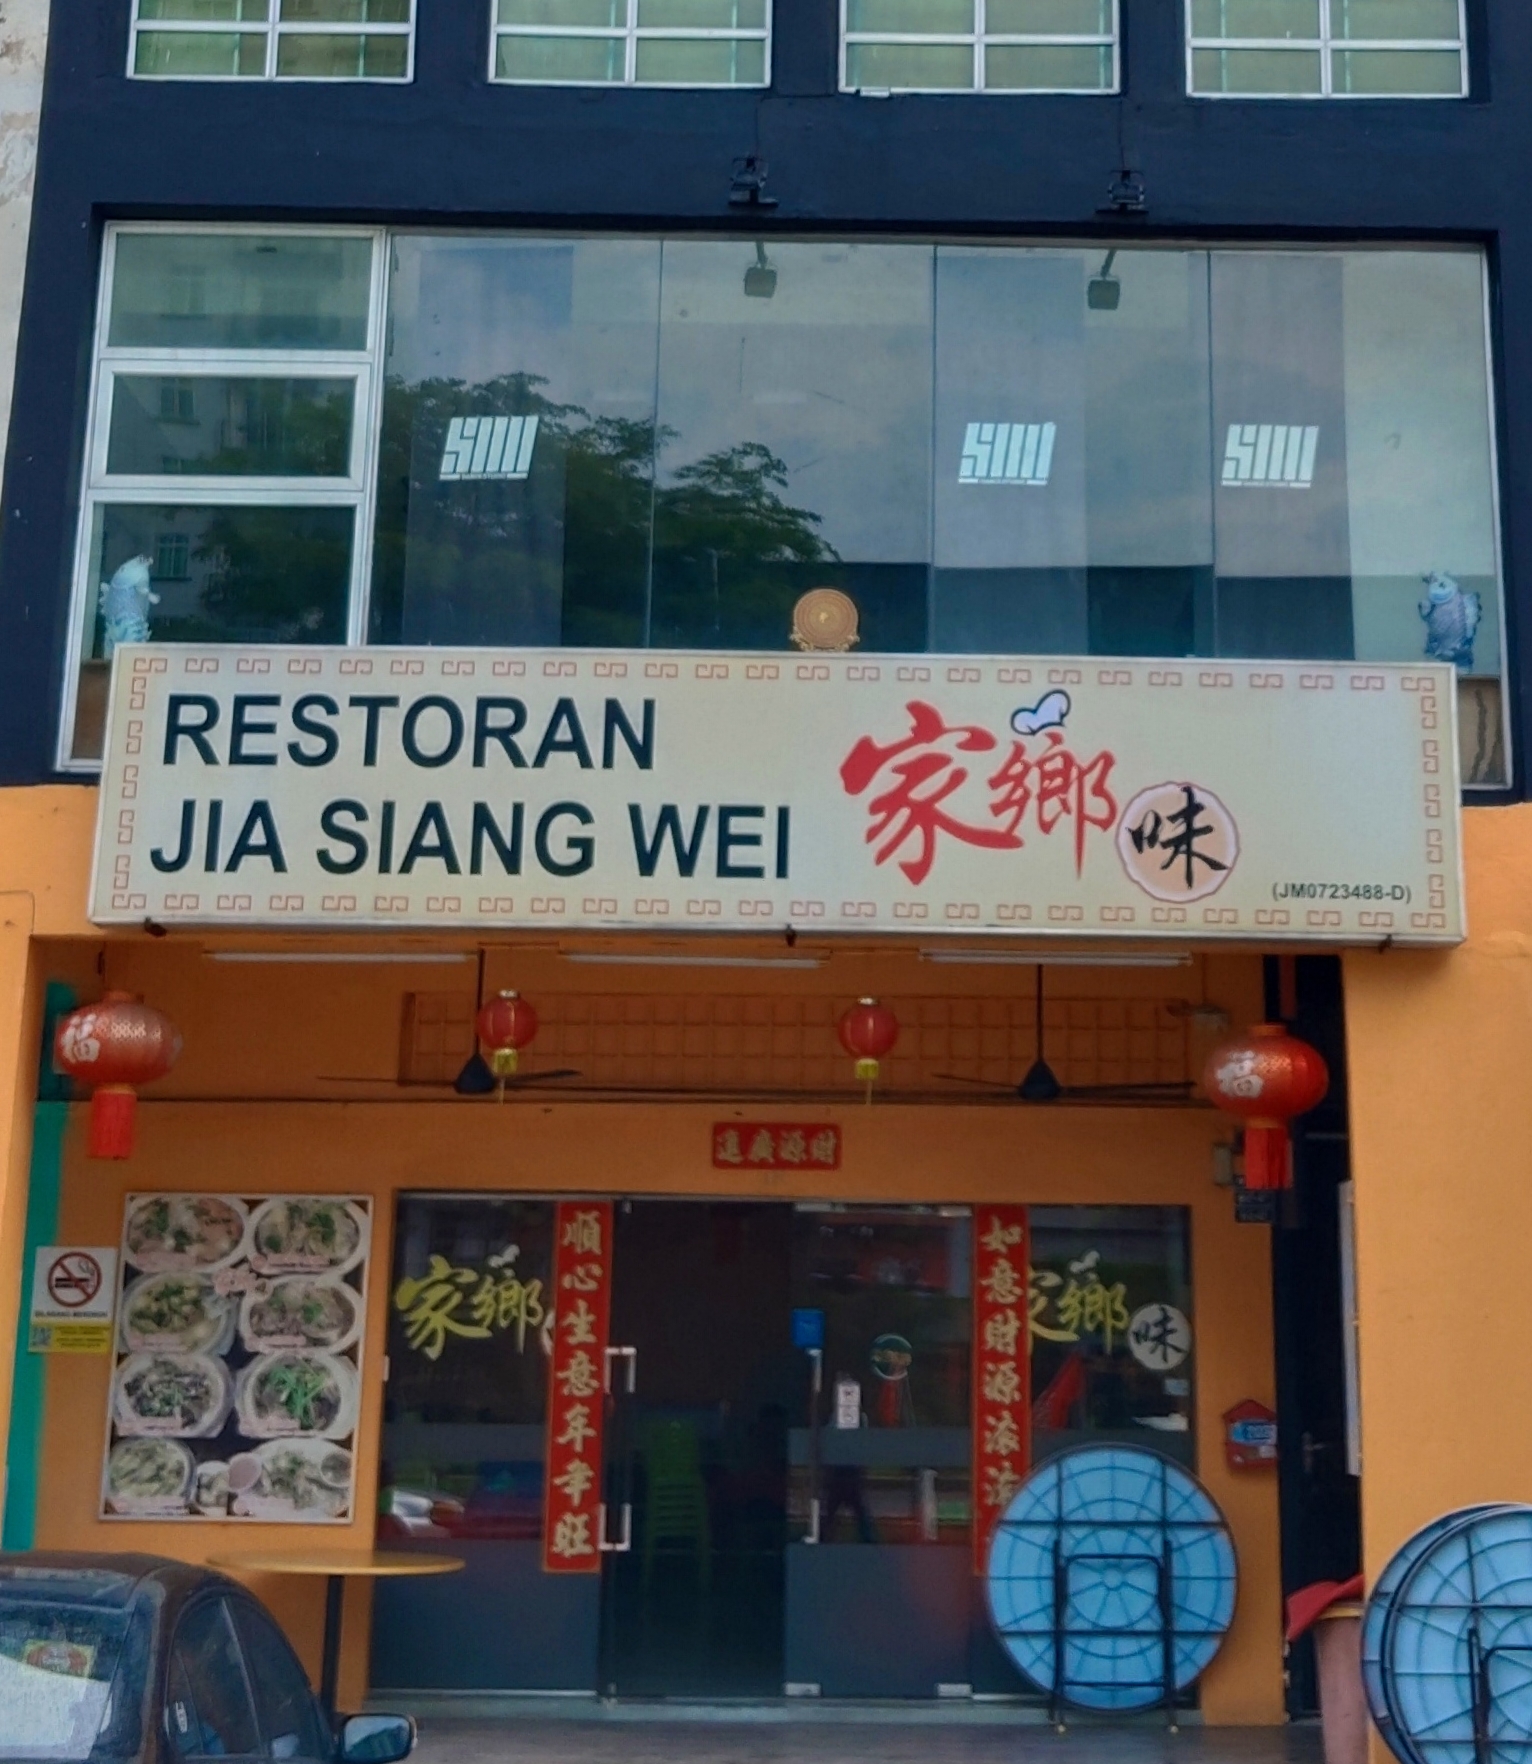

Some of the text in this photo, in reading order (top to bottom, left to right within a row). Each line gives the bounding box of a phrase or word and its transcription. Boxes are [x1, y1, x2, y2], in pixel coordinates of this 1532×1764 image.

[162, 693, 656, 771] RESTORAN
[839, 700, 1230, 889] 家鄉味
[150, 799, 790, 879] JIA SIANG WEI
[1272, 882, 1412, 905] (JM0723488-D)
